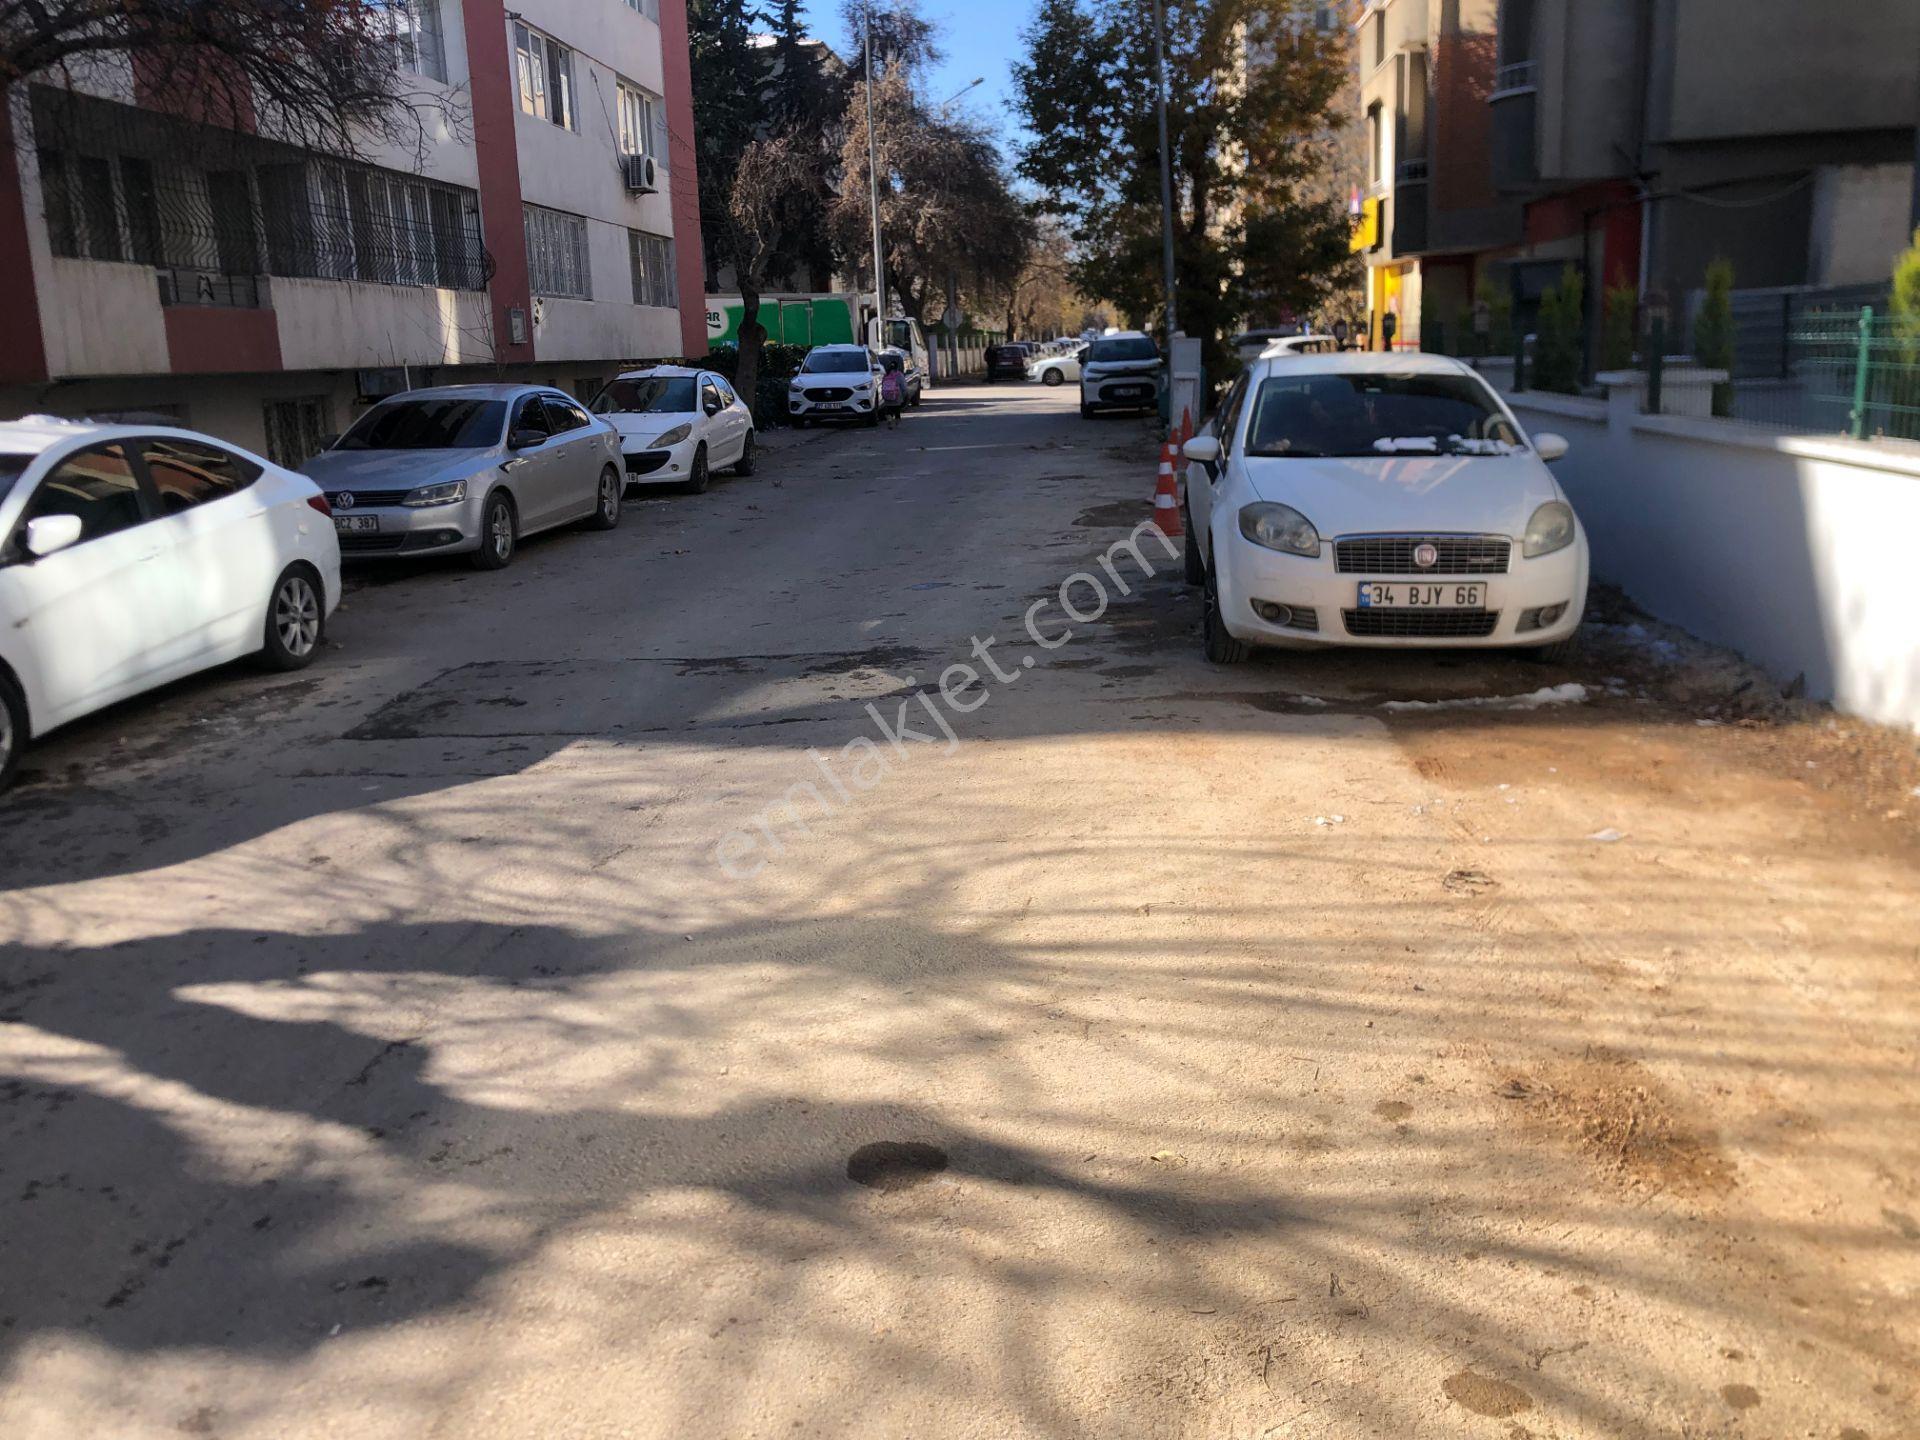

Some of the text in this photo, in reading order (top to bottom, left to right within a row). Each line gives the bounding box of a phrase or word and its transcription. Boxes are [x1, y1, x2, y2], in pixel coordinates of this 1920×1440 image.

[1372, 586, 1395, 605] 34
[1408, 586, 1444, 605] BJY
[1455, 586, 1478, 605] 66
